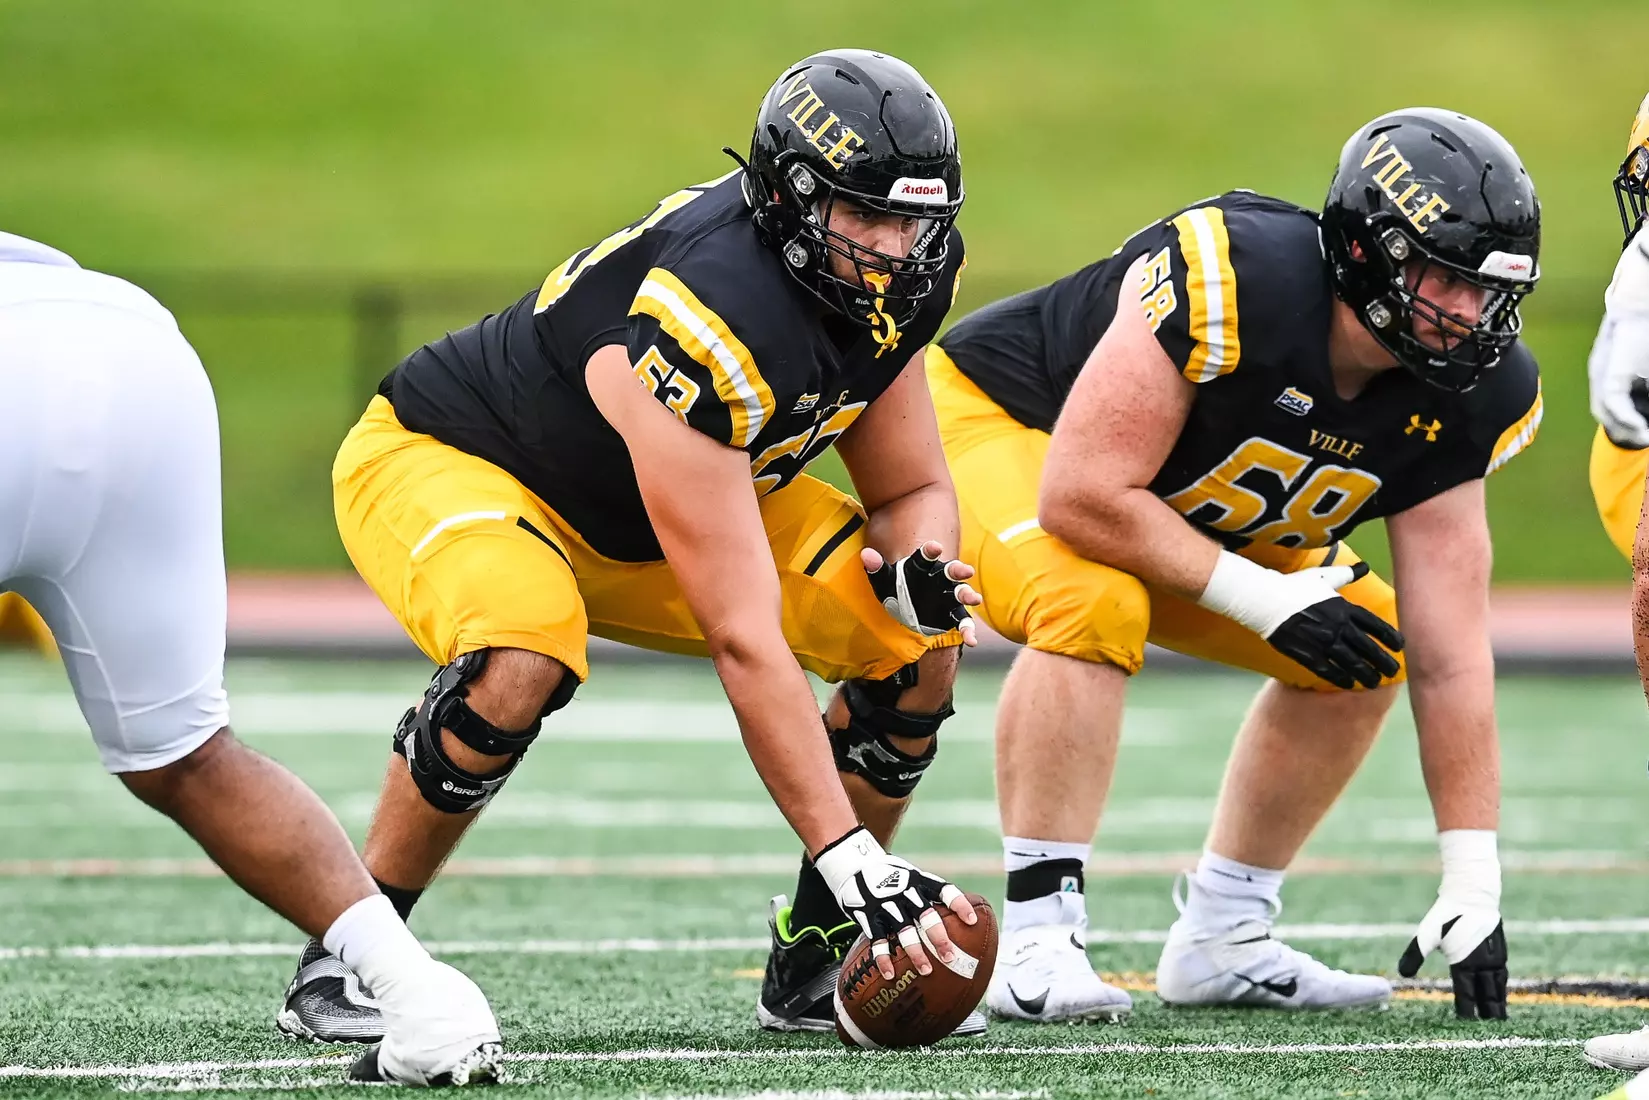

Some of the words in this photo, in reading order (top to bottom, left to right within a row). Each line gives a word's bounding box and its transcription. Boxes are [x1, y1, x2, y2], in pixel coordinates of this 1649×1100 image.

[778, 72, 865, 170] VILLE
[1361, 132, 1450, 234] VILLE
[1309, 429, 1364, 460] VILLE
[861, 969, 918, 1018] Wilson
